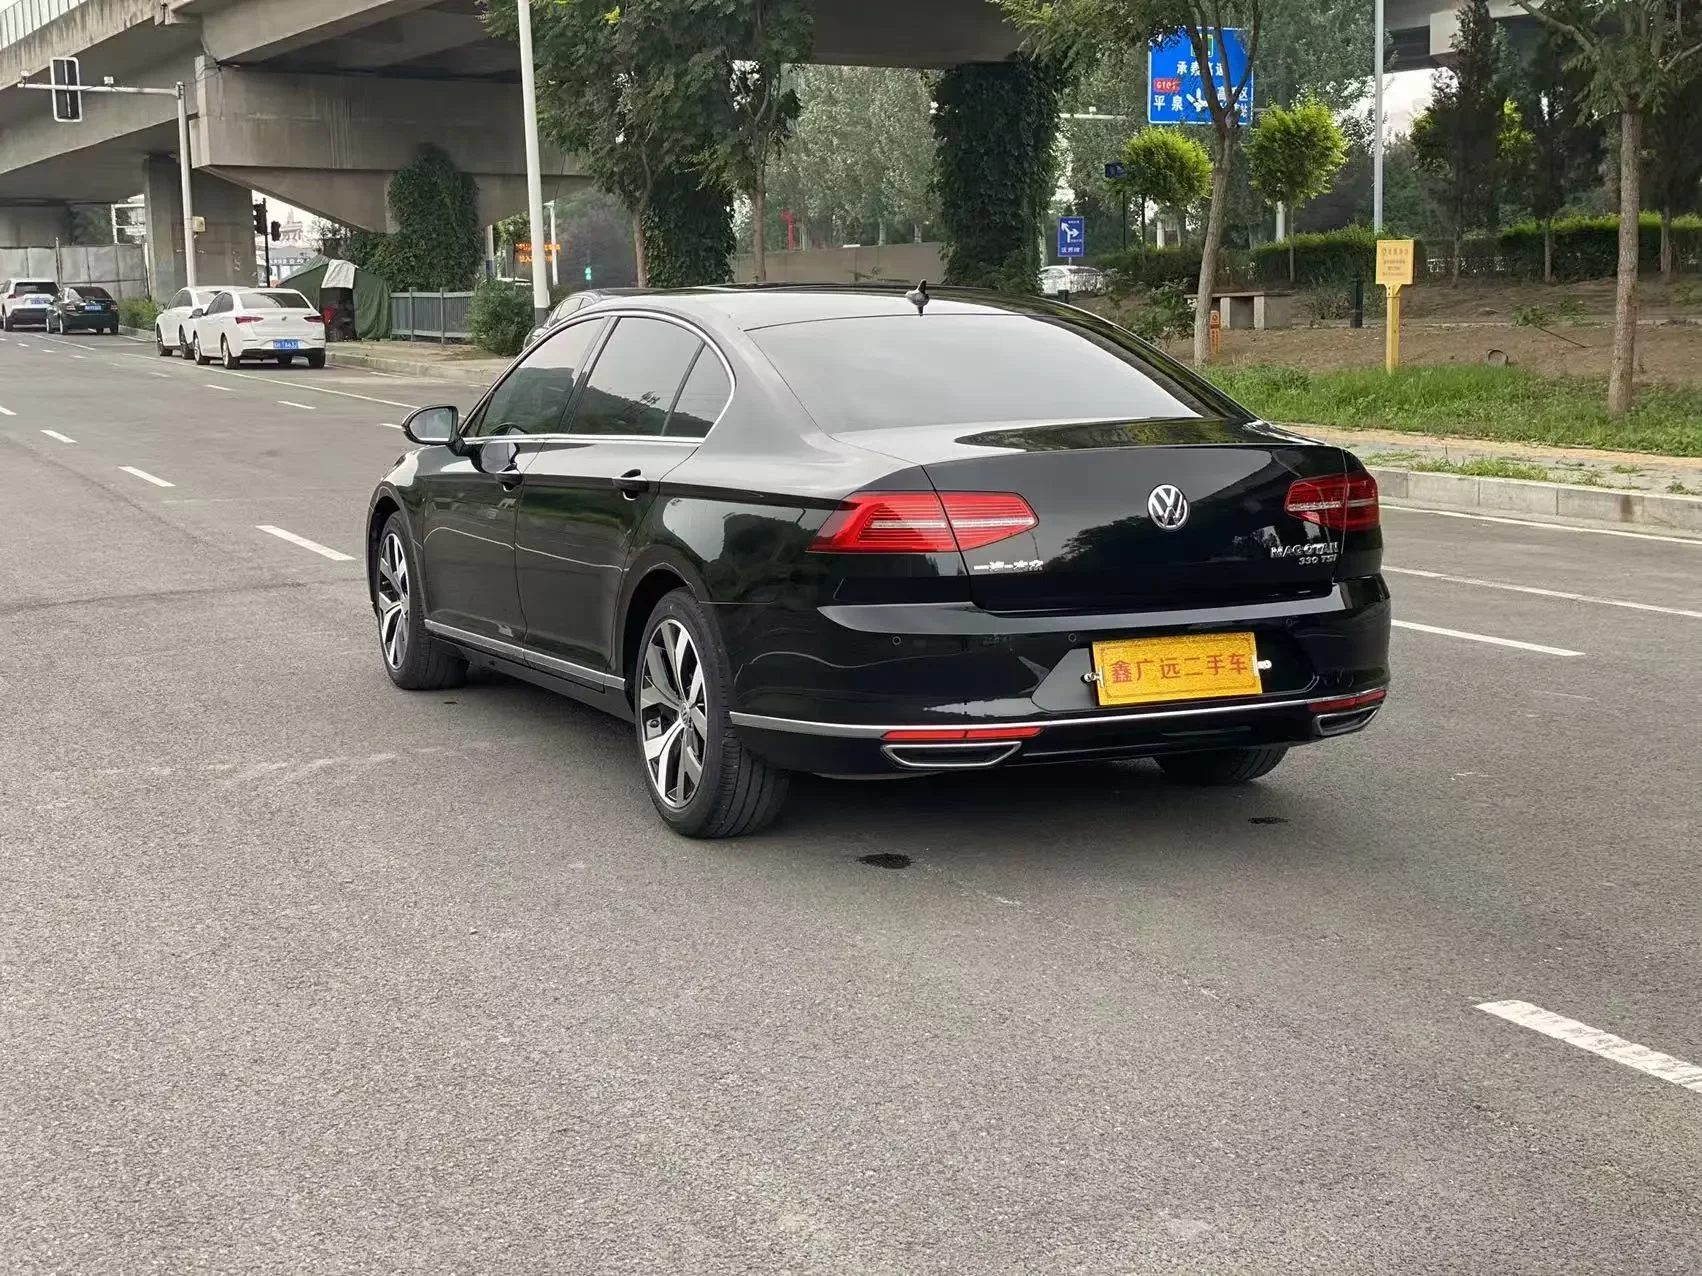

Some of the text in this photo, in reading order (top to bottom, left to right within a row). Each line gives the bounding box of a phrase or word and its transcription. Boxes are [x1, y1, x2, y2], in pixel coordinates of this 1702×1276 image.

[1153, 95, 1183, 112] 平泉
[1270, 542, 1339, 558] MAGOTAN
[1299, 556, 1319, 565] 330
[1111, 653, 1248, 684] 鑫广远二手车
